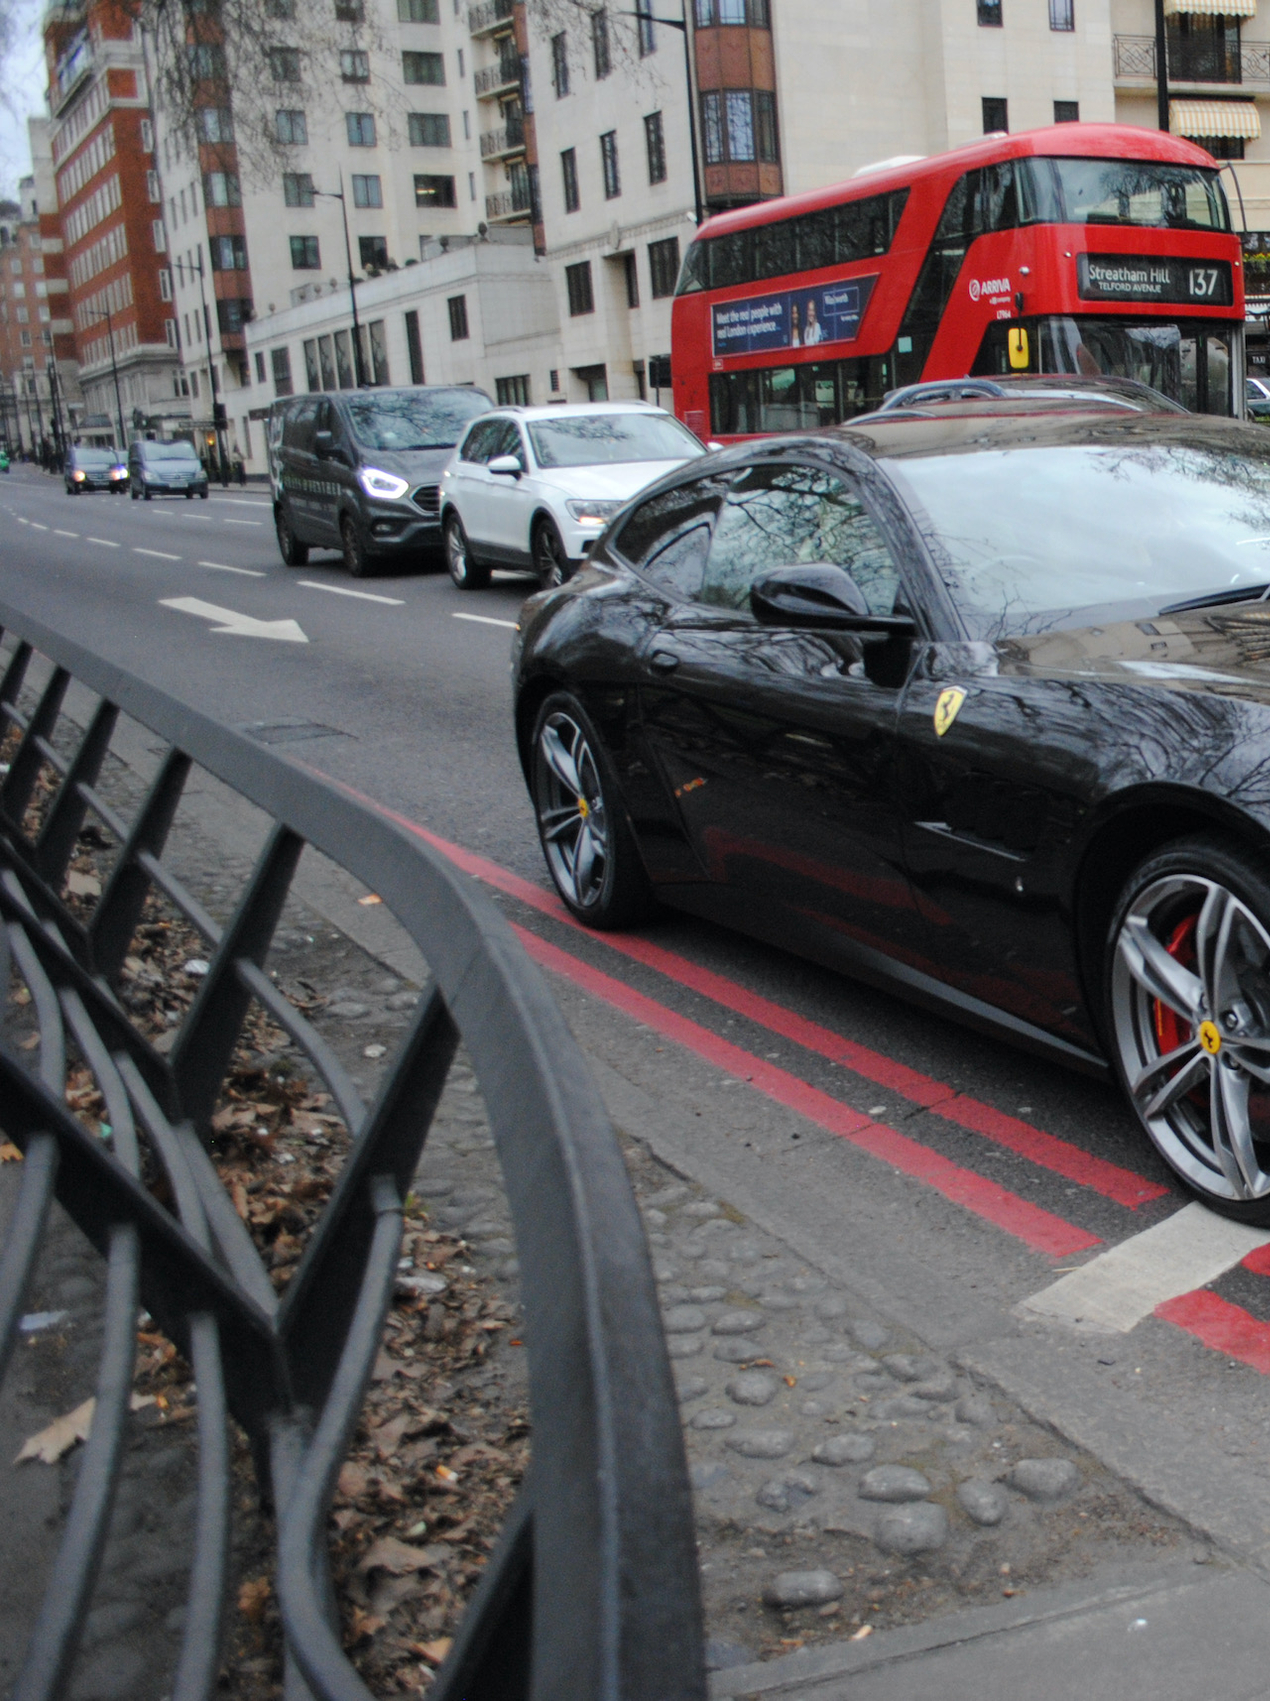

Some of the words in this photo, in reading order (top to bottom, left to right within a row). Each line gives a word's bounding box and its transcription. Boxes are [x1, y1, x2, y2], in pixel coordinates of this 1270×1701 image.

[1089, 264, 1148, 283] Streatham
[1150, 266, 1170, 284] Hill
[1189, 268, 1218, 296] 137
[981, 278, 1011, 295] ARRIVA
[1098, 282, 1131, 292] TELFORD
[1132, 284, 1162, 293] AVENUE
[1252, 356, 1266, 364] TAXI
